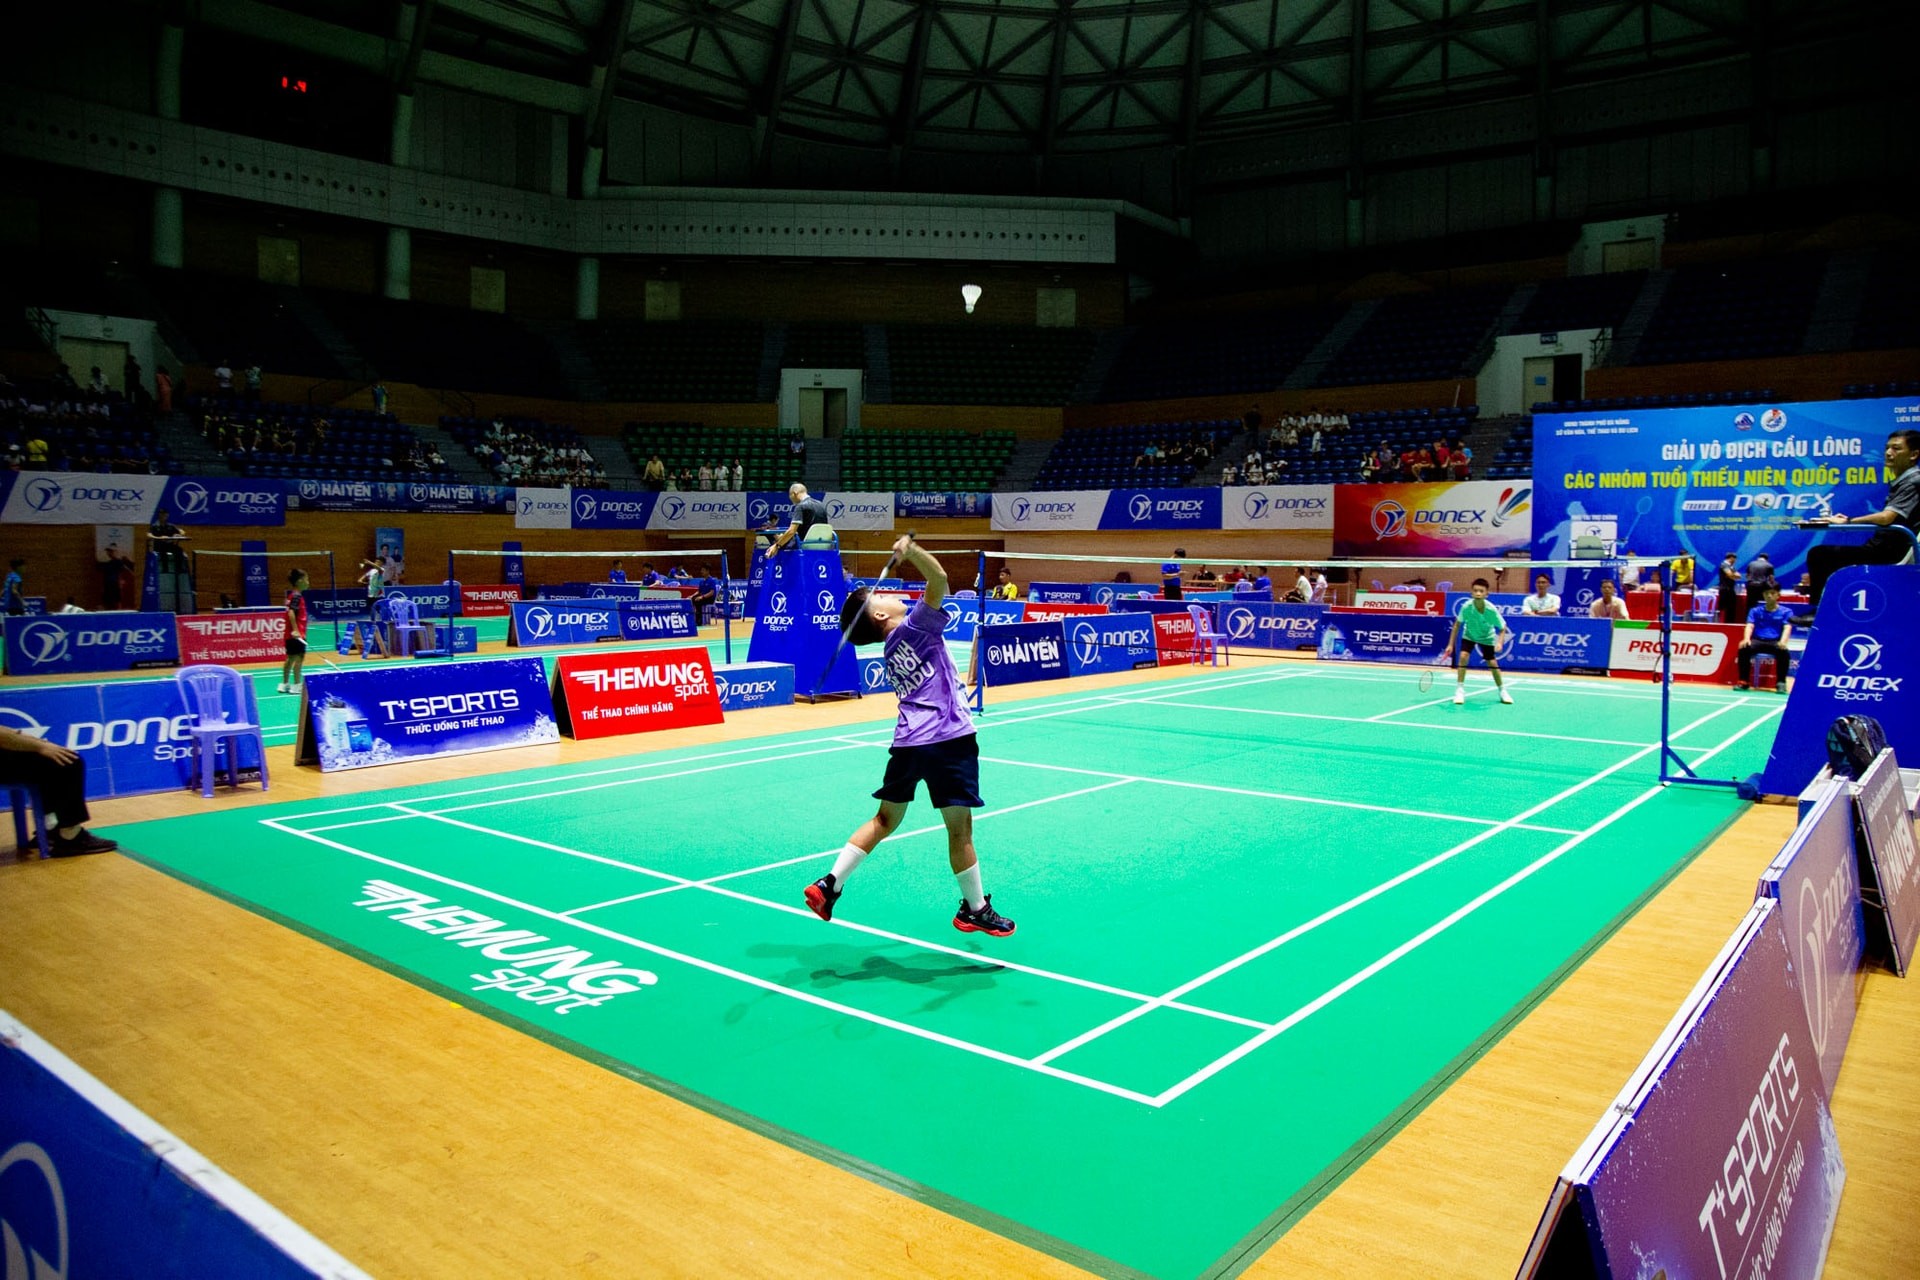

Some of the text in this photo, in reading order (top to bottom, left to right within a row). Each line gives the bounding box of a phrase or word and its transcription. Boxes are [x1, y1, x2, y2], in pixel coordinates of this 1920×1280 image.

[1662, 439, 1695, 460] GIẢI
[1700, 440, 1721, 460] VÔ
[1726, 441, 1767, 462] ĐỊCH
[1812, 435, 1862, 457] LÔNG
[1564, 469, 1595, 489] CÁC
[1599, 468, 1647, 489] NHÓM
[1651, 465, 1687, 488] TUỔI
[1692, 465, 1739, 488] THIẾU
[1744, 466, 1786, 487] NIÊN
[1791, 462, 1840, 487] QUỐC
[1845, 466, 1878, 485] GIA
[72, 487, 144, 501] DONEX
[215, 491, 280, 504] DONEX
[99, 501, 141, 513] Sport
[536, 502, 568, 510] DONEX
[600, 501, 643, 513] DONEX
[691, 502, 741, 512] DONEX
[849, 504, 889, 512] DONEX
[1035, 503, 1076, 513] DONEX
[1156, 500, 1204, 511] DONEX
[1274, 497, 1327, 509] DONEX
[238, 504, 276, 515] Sport
[616, 511, 640, 520] Sport
[1172, 510, 1201, 520] Sport
[1292, 509, 1324, 519] Sport
[1049, 513, 1074, 521] Sport
[1414, 509, 1486, 524] DONEX
[1439, 525, 1481, 536] Sport
[775, 565, 783, 578] 2
[818, 565, 827, 578] 2
[1582, 568, 1592, 580] 7
[1851, 589, 1870, 611] 1
[557, 612, 609, 625] DONEX
[763, 615, 794, 625] DONEX
[1258, 617, 1319, 631] DONEX
[184, 618, 286, 635] THEMUNG
[584, 624, 608, 632] Sport
[769, 624, 788, 632] Sport
[820, 623, 839, 631] Sport
[76, 628, 167, 647] DONEX
[1103, 629, 1149, 648] DONEX
[1286, 630, 1315, 639] Sport
[1518, 632, 1591, 647] DONEX
[123, 644, 164, 655] Sport
[211, 650, 236, 659] THAO
[1543, 646, 1586, 657] Sport
[570, 662, 704, 692] THEMUNG
[1817, 674, 1903, 692] DONEX
[674, 678, 710, 701] sport
[730, 681, 776, 695] DONEX
[743, 693, 764, 701] Sport
[1834, 690, 1883, 702] Sport
[600, 707, 622, 718] THAO
[624, 704, 650, 716] CHÍNH
[652, 702, 674, 713] HÃNG
[404, 723, 432, 735] THỨC
[433, 719, 460, 732] UỐNG
[480, 715, 506, 726] THAO
[352, 879, 659, 996] THEMUNG
[470, 968, 615, 1015] sport
[1787, 1140, 1805, 1193] THAO
